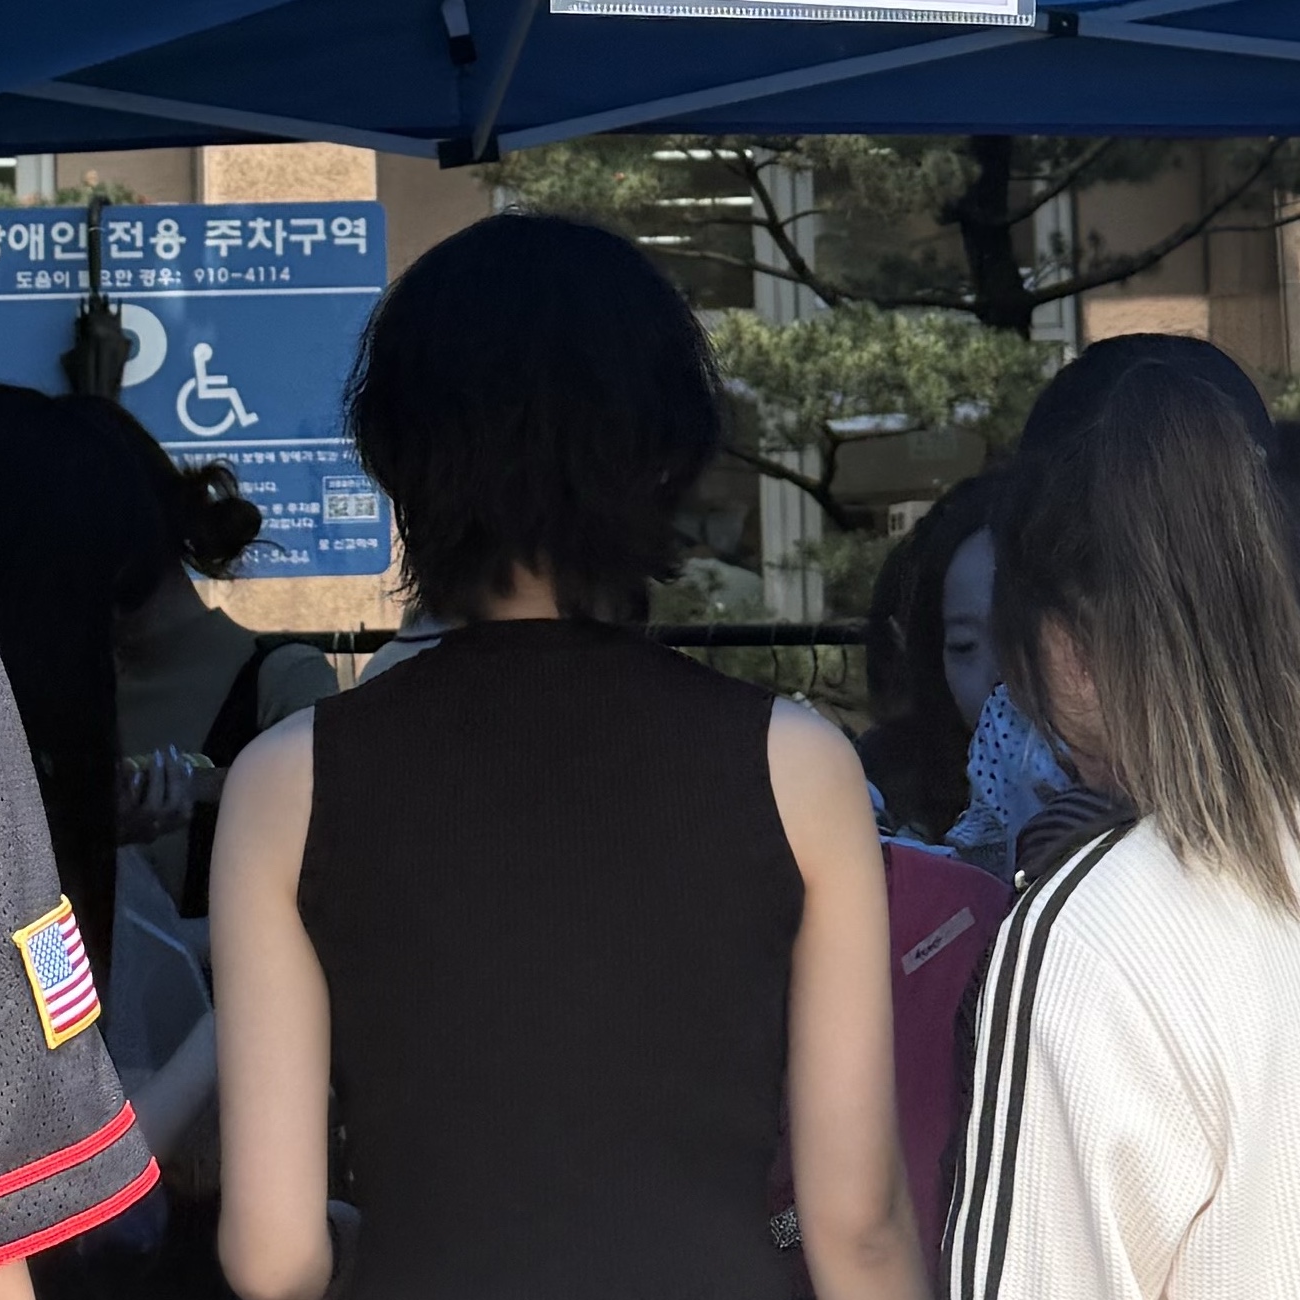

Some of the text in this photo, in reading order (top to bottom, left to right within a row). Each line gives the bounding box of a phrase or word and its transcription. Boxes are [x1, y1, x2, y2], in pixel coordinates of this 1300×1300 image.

[108, 218, 187, 260] 전용
[204, 216, 368, 255] 주차구역
[16, 270, 70, 289] 도움이
[194, 266, 291, 284] 910-4114
